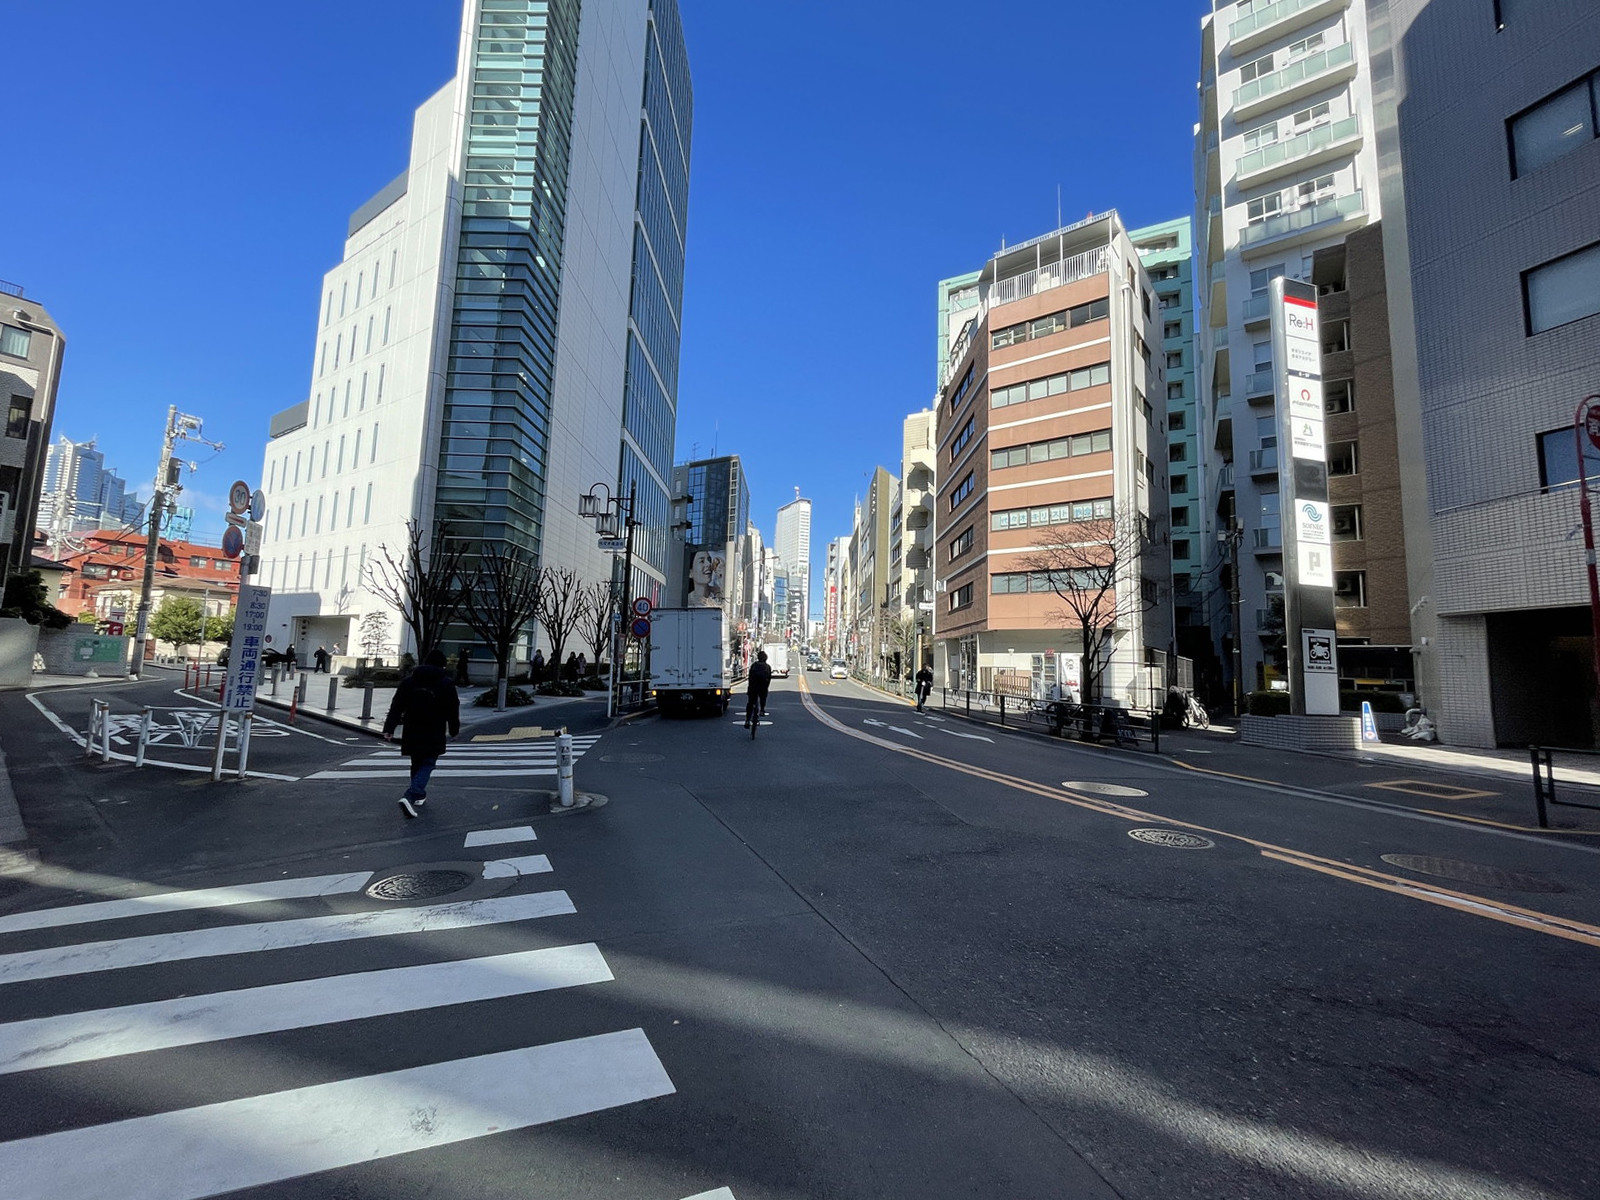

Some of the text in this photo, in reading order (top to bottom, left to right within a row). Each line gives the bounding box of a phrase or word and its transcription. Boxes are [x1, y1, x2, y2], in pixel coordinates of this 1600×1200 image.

[1288, 313, 1314, 332] Re:H
[234, 489, 246, 506] 30
[637, 603, 649, 612] 40
[245, 611, 265, 619] 17:00
[243, 623, 263, 632] 19:00
[234, 636, 260, 708] 車両通行禁止
